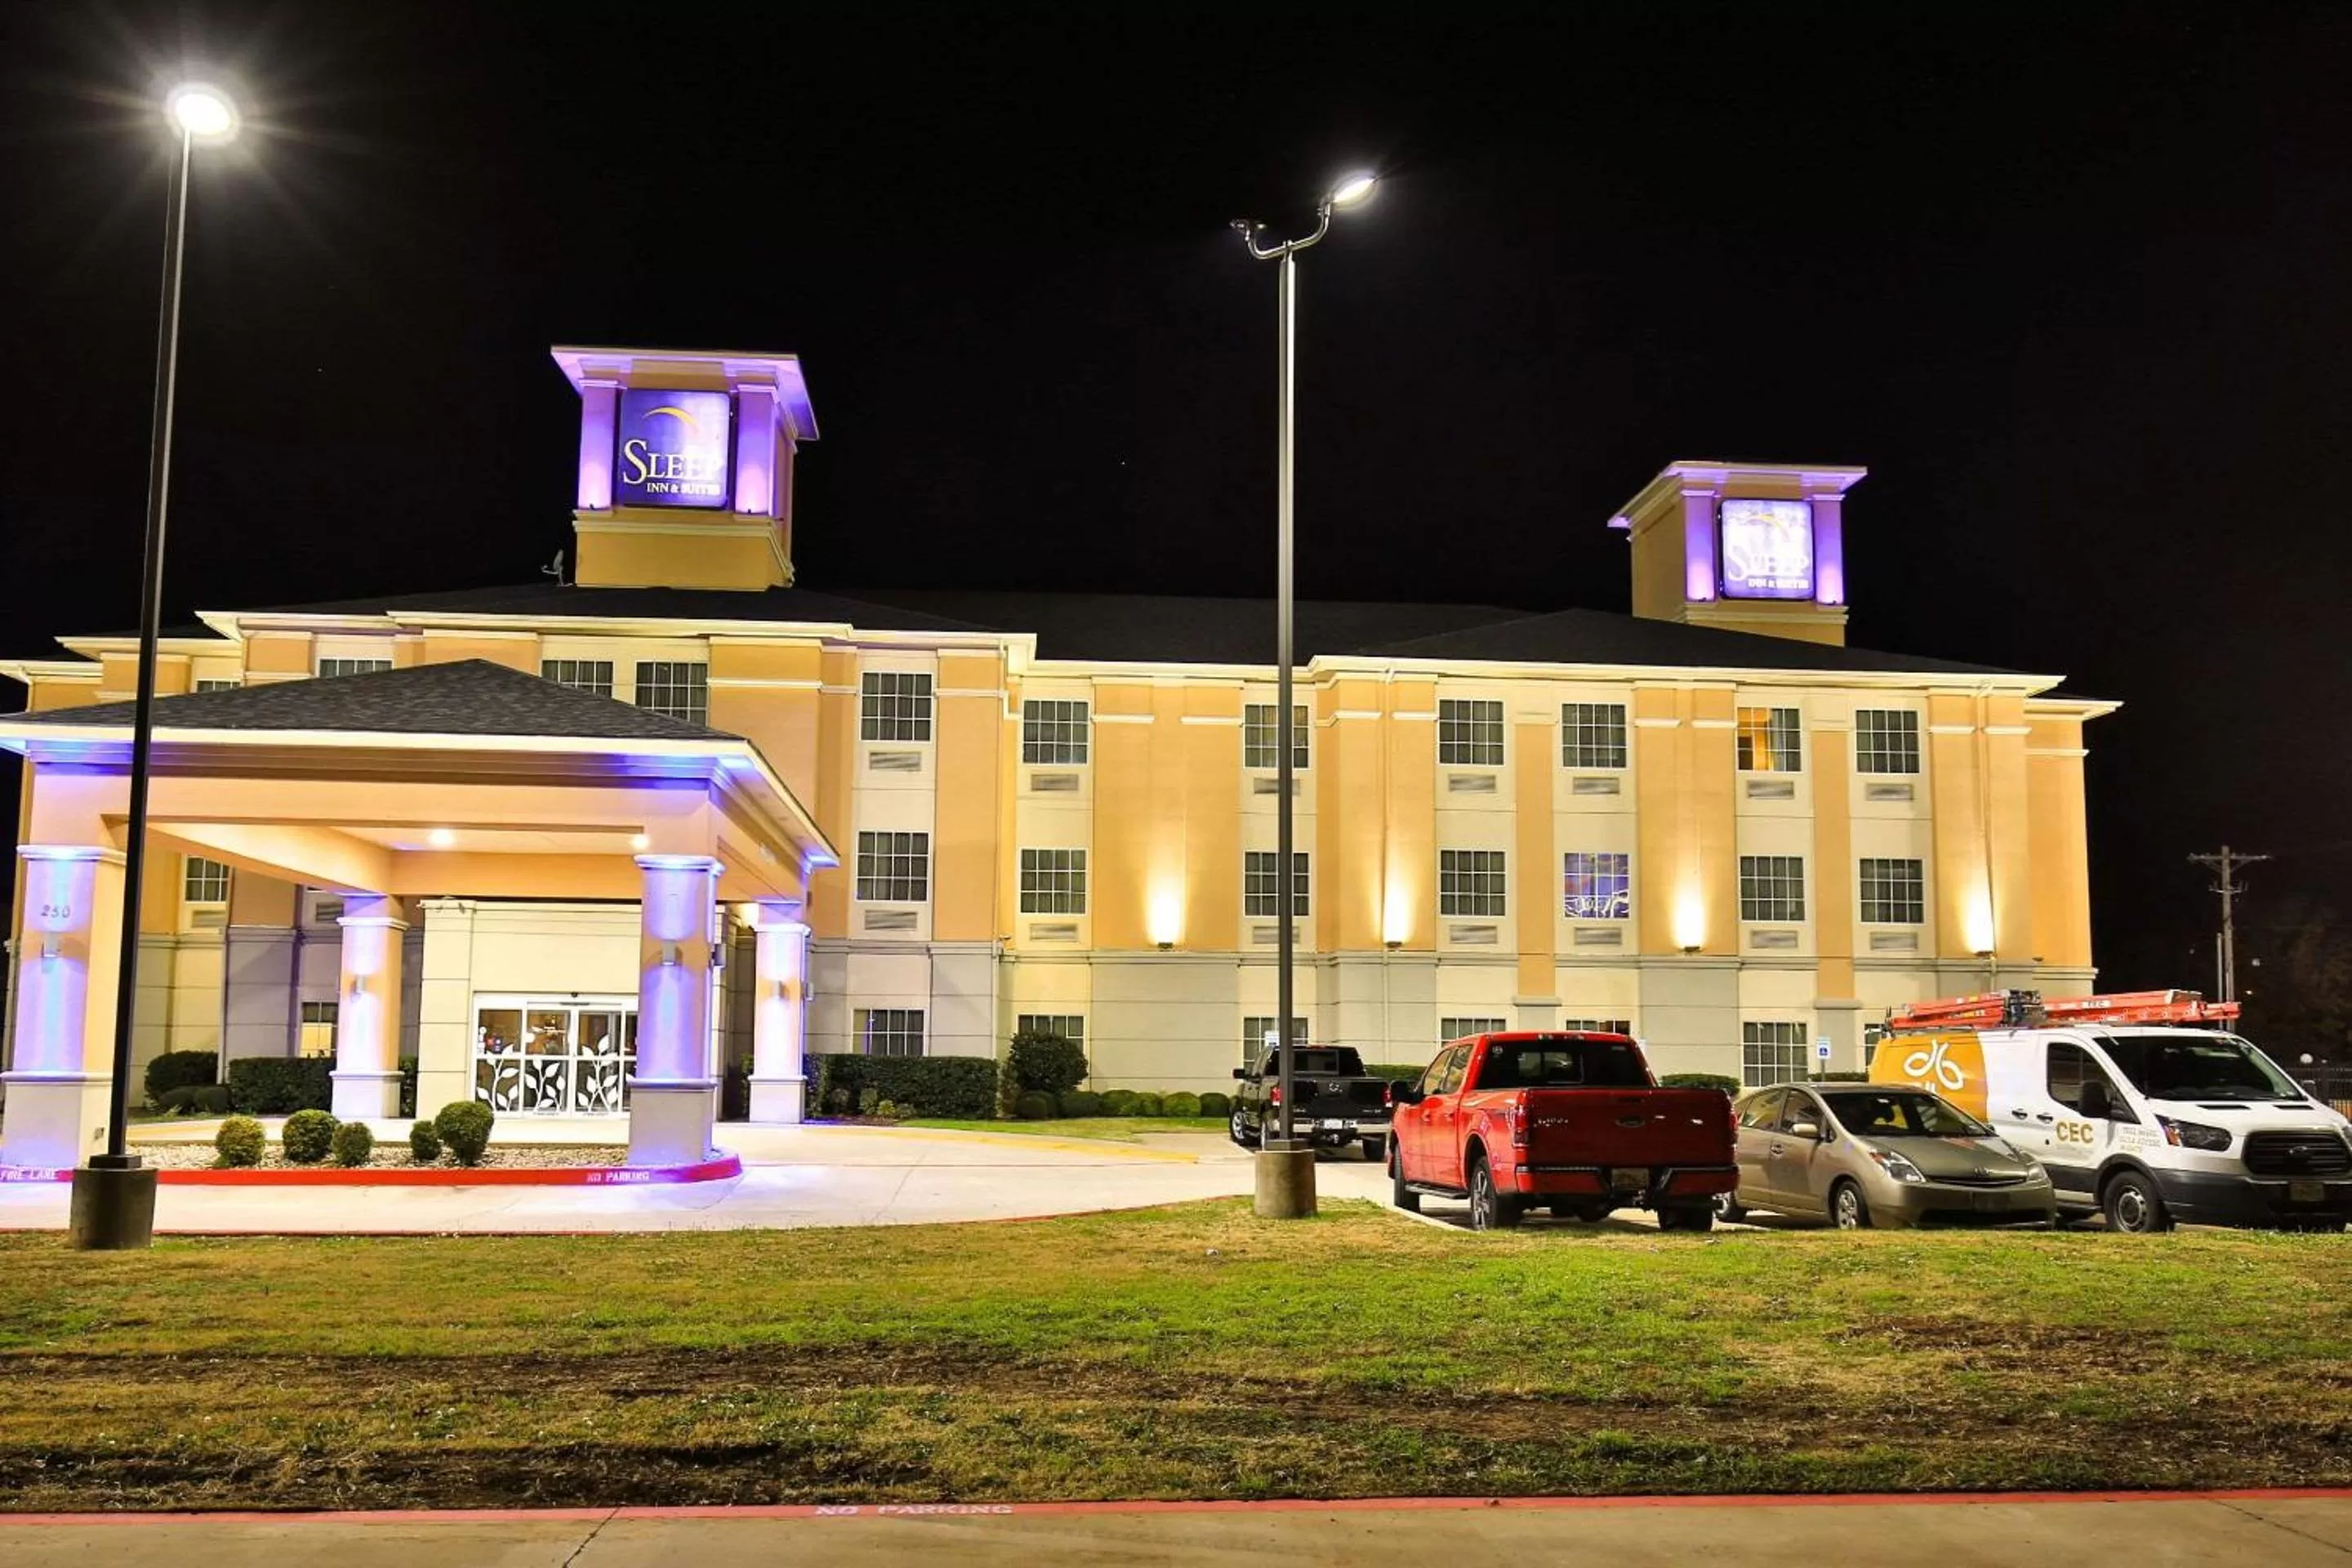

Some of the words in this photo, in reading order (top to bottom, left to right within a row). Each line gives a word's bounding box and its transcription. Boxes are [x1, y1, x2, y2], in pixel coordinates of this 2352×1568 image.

[647, 483, 669, 493] INN
[670, 484, 679, 493] &
[40, 904, 71, 919] 250
[2056, 1121, 2094, 1143] CEC
[586, 1172, 602, 1183] NO
[606, 1171, 650, 1182] PARKING
[816, 1504, 858, 1516] NO
[878, 1504, 1013, 1515] PARKING
